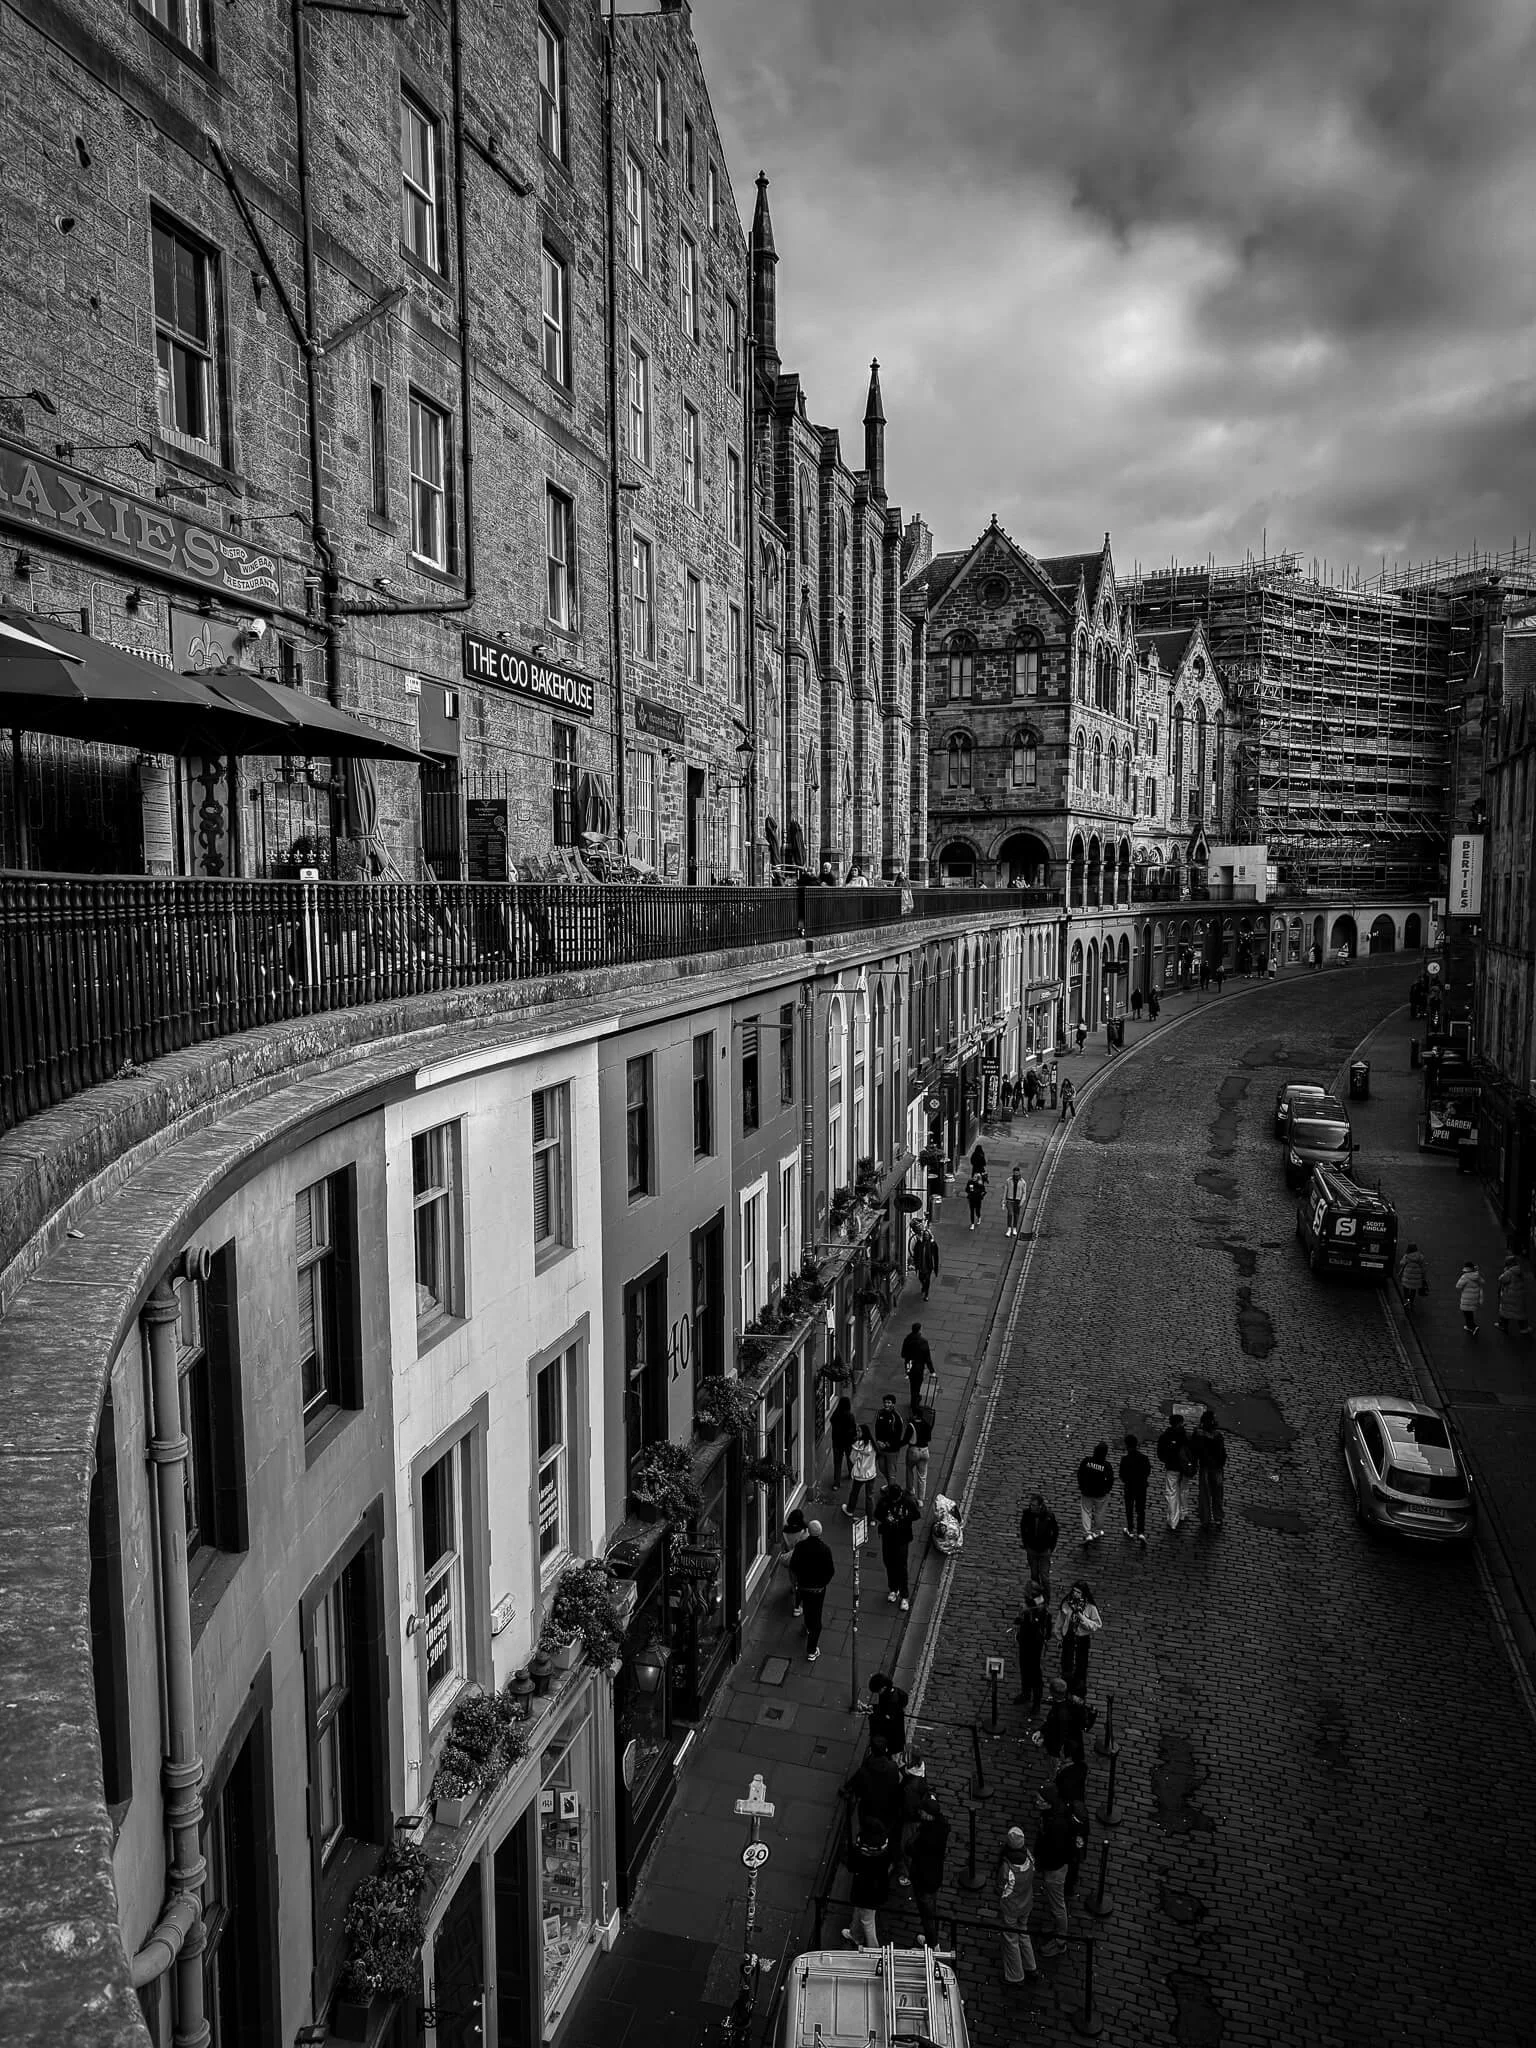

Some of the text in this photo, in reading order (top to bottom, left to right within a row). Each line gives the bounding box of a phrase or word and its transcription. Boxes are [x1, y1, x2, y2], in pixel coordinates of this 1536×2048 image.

[0, 463, 220, 577] AXIES
[222, 546, 246, 560] BISTRO
[226, 576, 275, 589] RESTAURANT
[468, 640, 593, 711] THE COO BAKEHOUSE
[1461, 840, 1470, 908] BERTIES
[1432, 1129, 1450, 1140] OPEN
[1446, 1119, 1472, 1130] GARDEN
[665, 1312, 691, 1384] 40
[430, 1588, 448, 1624] Local
[429, 1632, 448, 1668] 2003
[745, 1848, 767, 1861] 20
